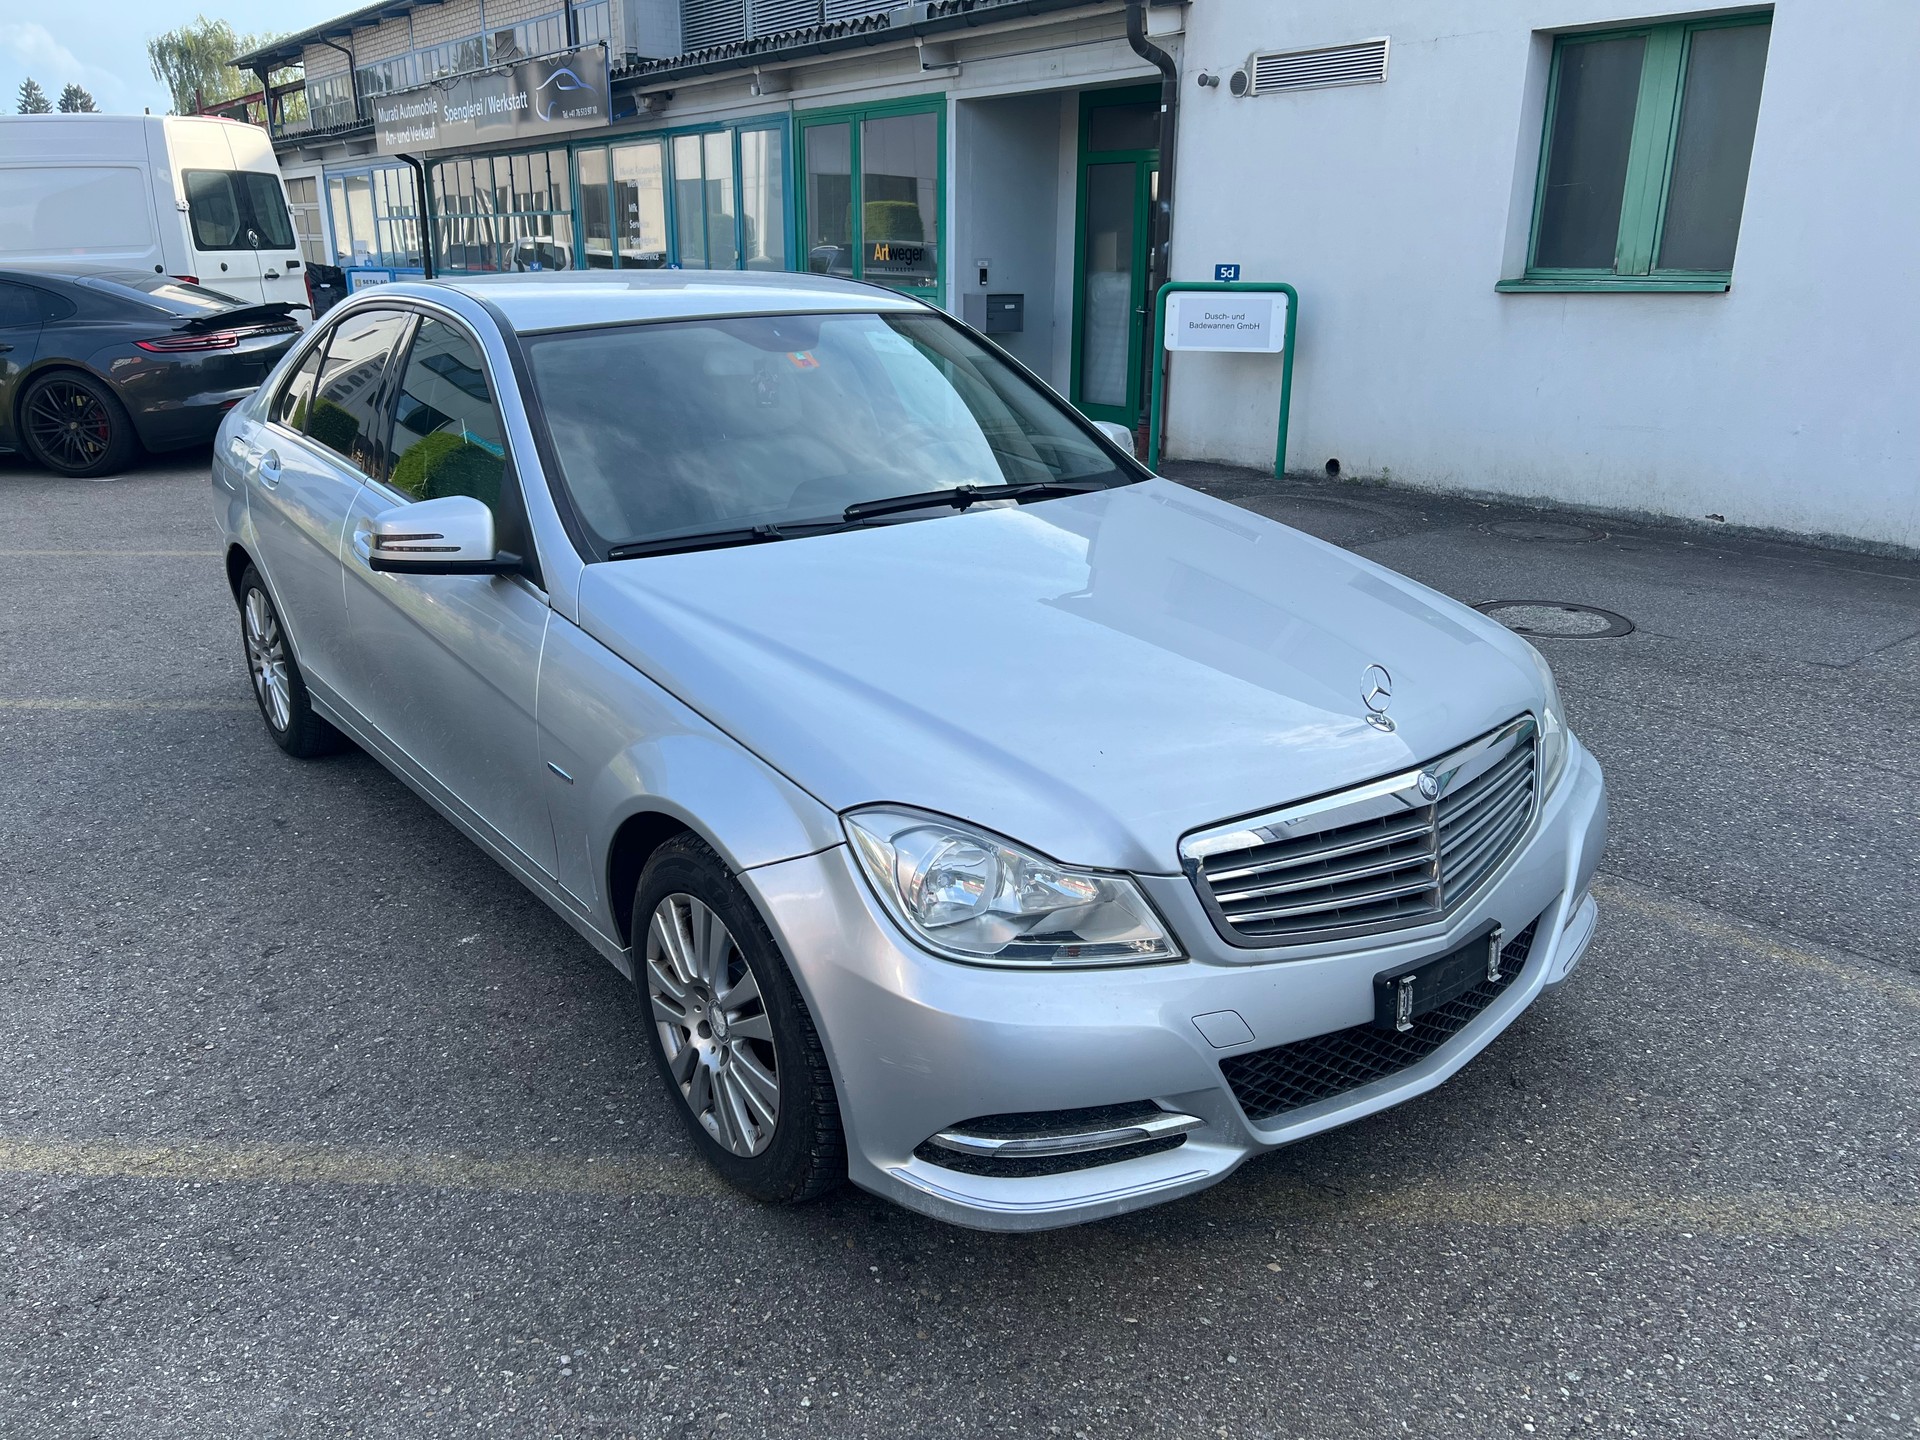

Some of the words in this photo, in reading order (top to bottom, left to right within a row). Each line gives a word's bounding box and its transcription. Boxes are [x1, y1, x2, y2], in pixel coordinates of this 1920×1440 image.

[378, 106, 399, 123] Murati
[400, 97, 438, 119] Automobile
[443, 99, 484, 125] Spenglerei
[487, 91, 528, 114] Werkstatt
[397, 126, 409, 144] und
[409, 121, 436, 142] Verkauf
[873, 243, 924, 265] Artweger
[1220, 266, 1235, 278] 5d
[1189, 322, 1235, 330] Badewannen
[1236, 322, 1260, 330] GmbH
[1204, 312, 1230, 320] Dusch-
